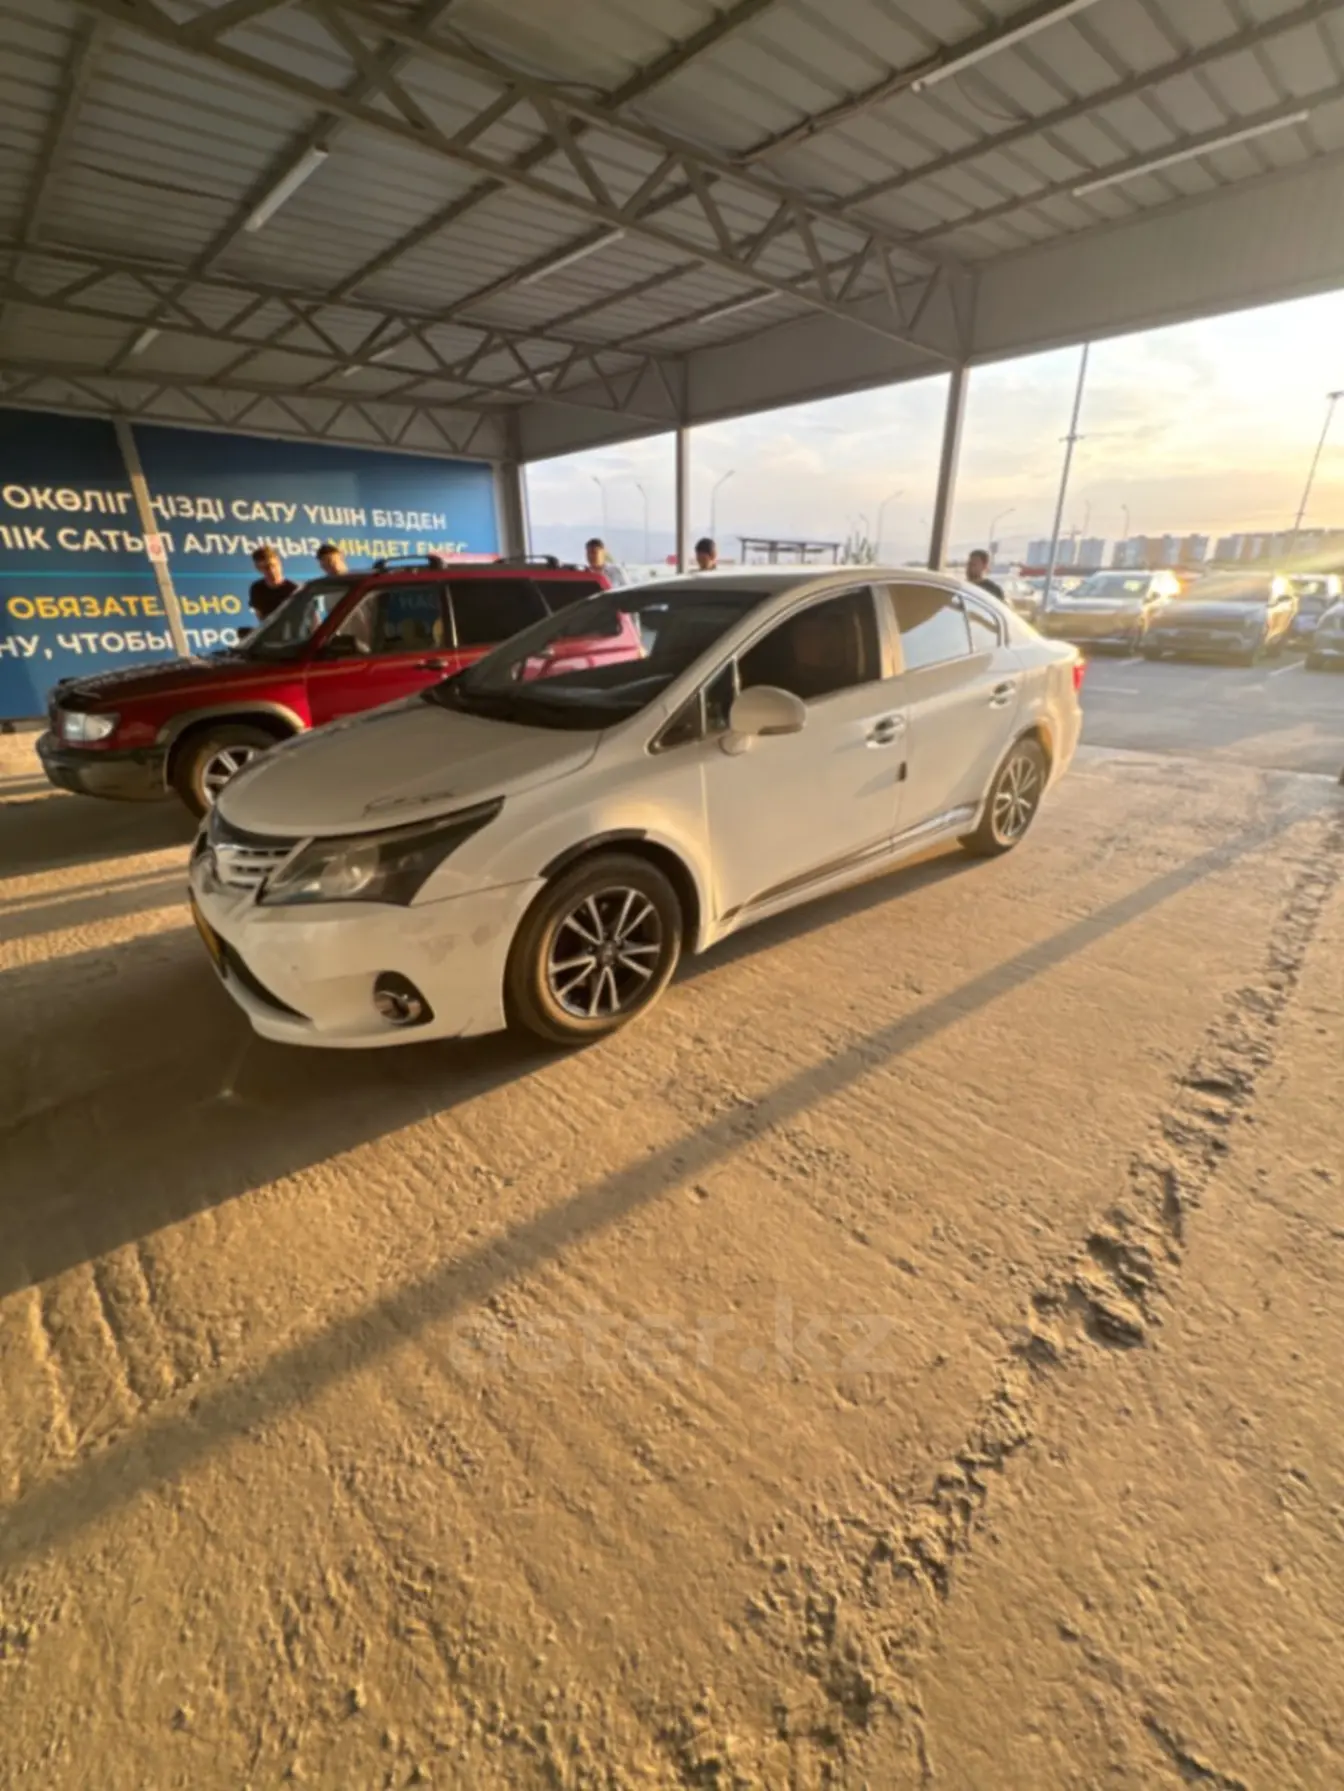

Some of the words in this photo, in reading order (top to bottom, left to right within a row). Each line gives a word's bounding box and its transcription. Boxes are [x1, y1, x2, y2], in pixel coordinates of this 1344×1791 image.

[2, 485, 225, 523] ОКӨЛІГҢІЗДІ
[231, 499, 297, 524] САТУ
[303, 504, 366, 527] ҮШІН
[372, 508, 447, 531] БІЗДЕН
[7, 595, 242, 619] ОБЯЗАТЕЬНО
[57, 630, 174, 655] ЧТОБЫ
